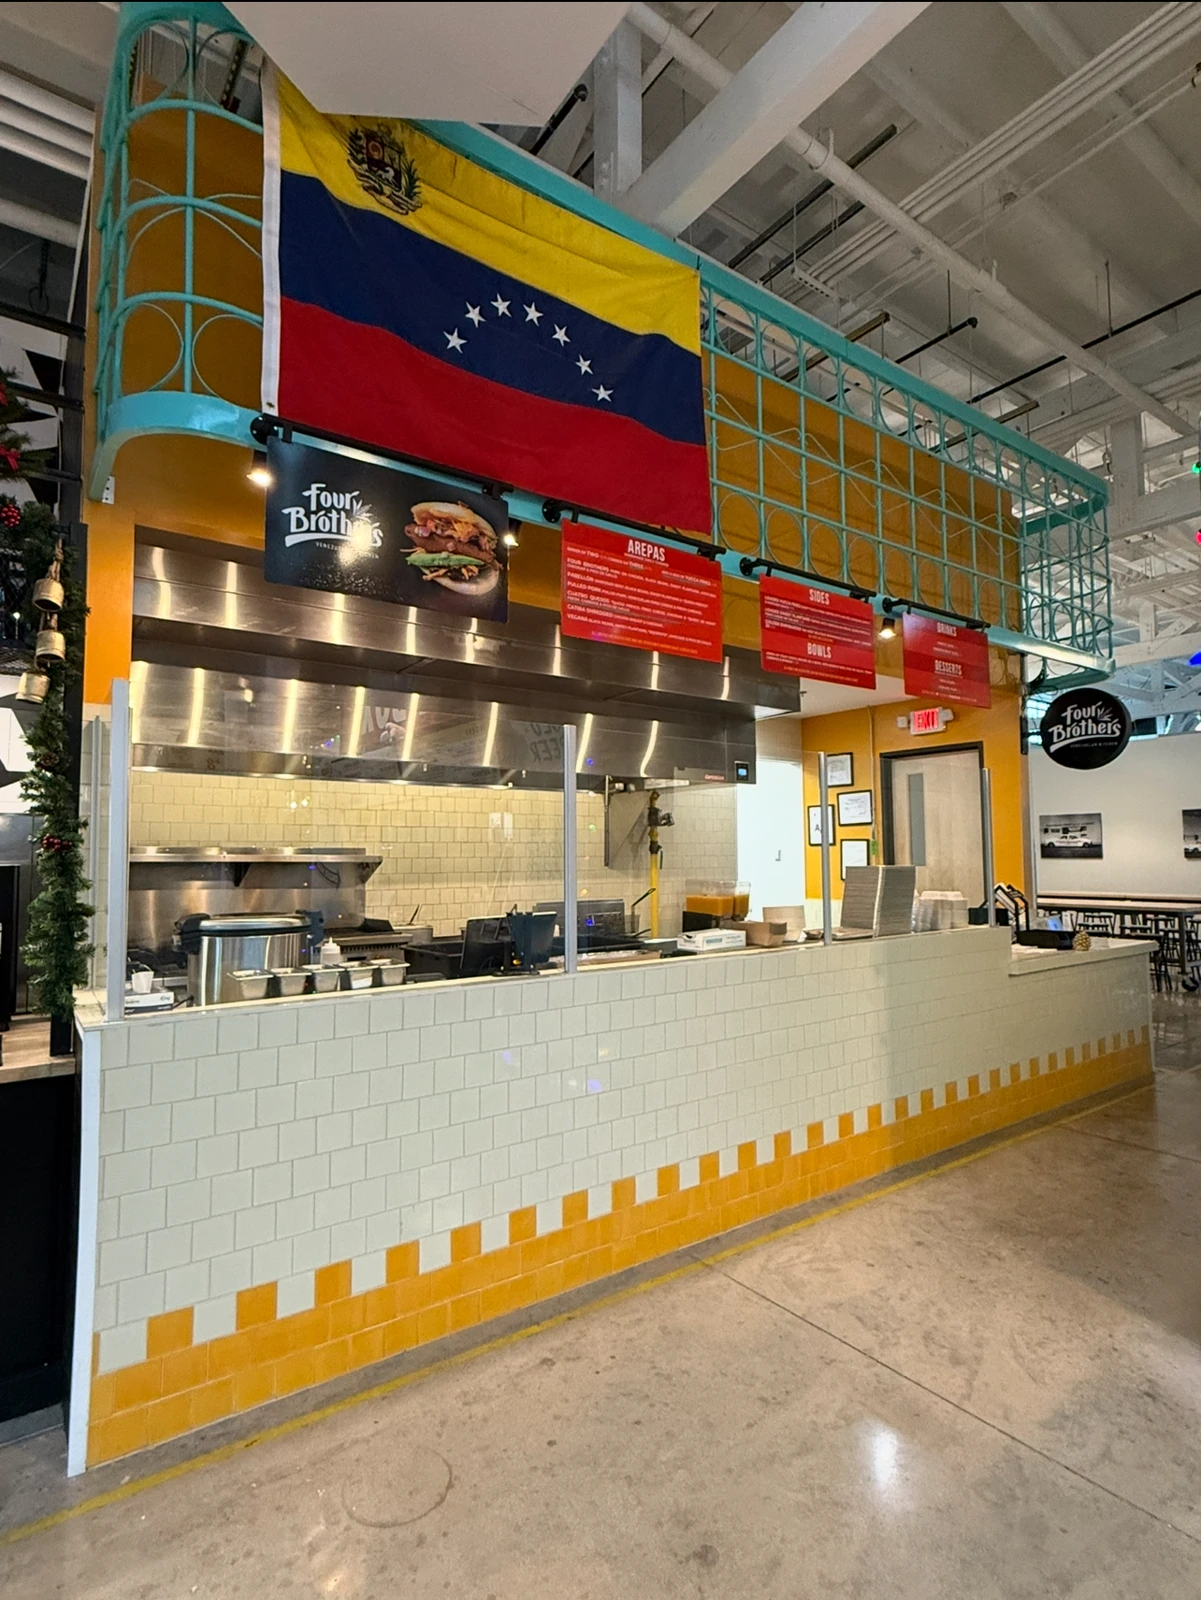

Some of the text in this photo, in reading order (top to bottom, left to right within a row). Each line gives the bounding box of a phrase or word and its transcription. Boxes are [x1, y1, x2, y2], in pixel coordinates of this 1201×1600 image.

[301, 483, 360, 511] Four
[282, 506, 384, 548] Broths
[628, 539, 666, 562] AREPAS
[809, 588, 830, 605] SIDES
[937, 622, 957, 637] DRINKS
[807, 643, 832, 659] BOWLS
[934, 660, 962, 676] DESSERTS
[916, 709, 937, 730] EXIT
[1061, 701, 1103, 725] Four
[1048, 718, 1122, 743] Brothers
